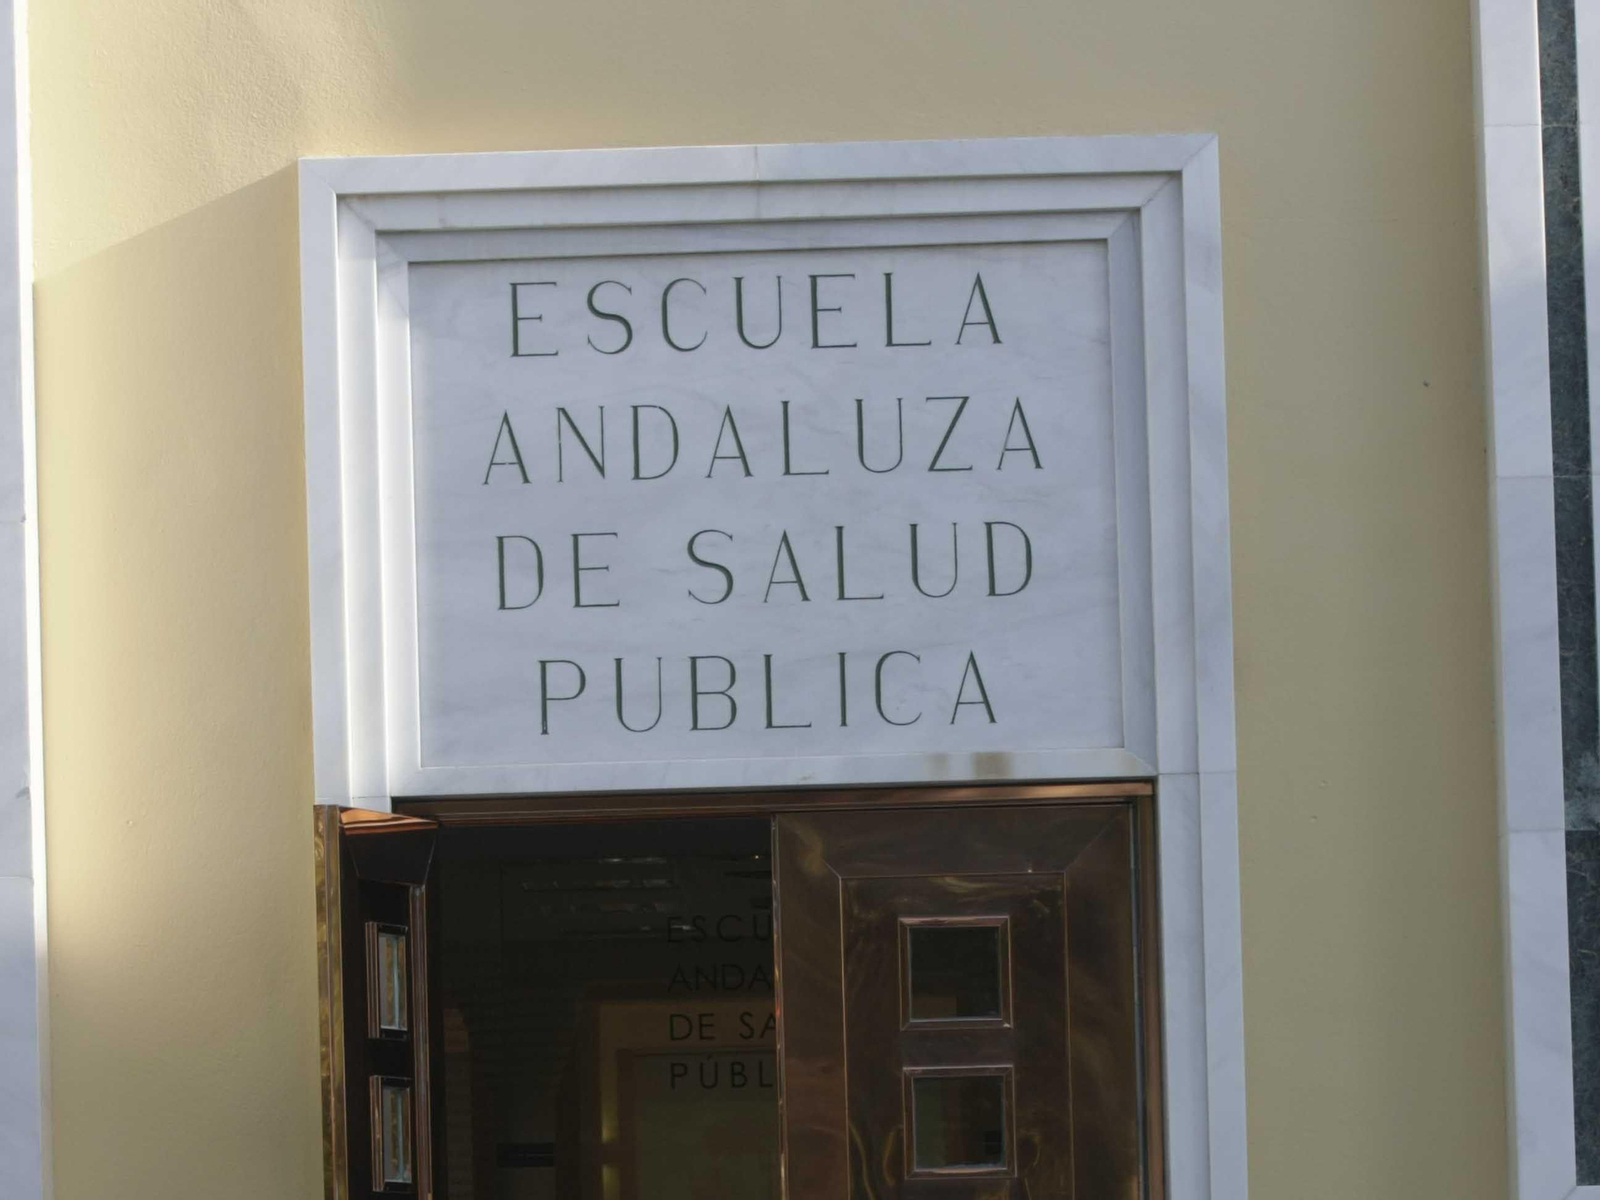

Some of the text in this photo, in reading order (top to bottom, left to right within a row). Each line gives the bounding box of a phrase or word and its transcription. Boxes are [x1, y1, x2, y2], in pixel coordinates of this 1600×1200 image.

[509, 272, 1003, 358] ESCUELA
[482, 396, 1044, 485] ANDALUZA
[495, 521, 1034, 610] DE SALUD
[537, 650, 998, 736] PUBLICA
[669, 1013, 716, 1041] DE
